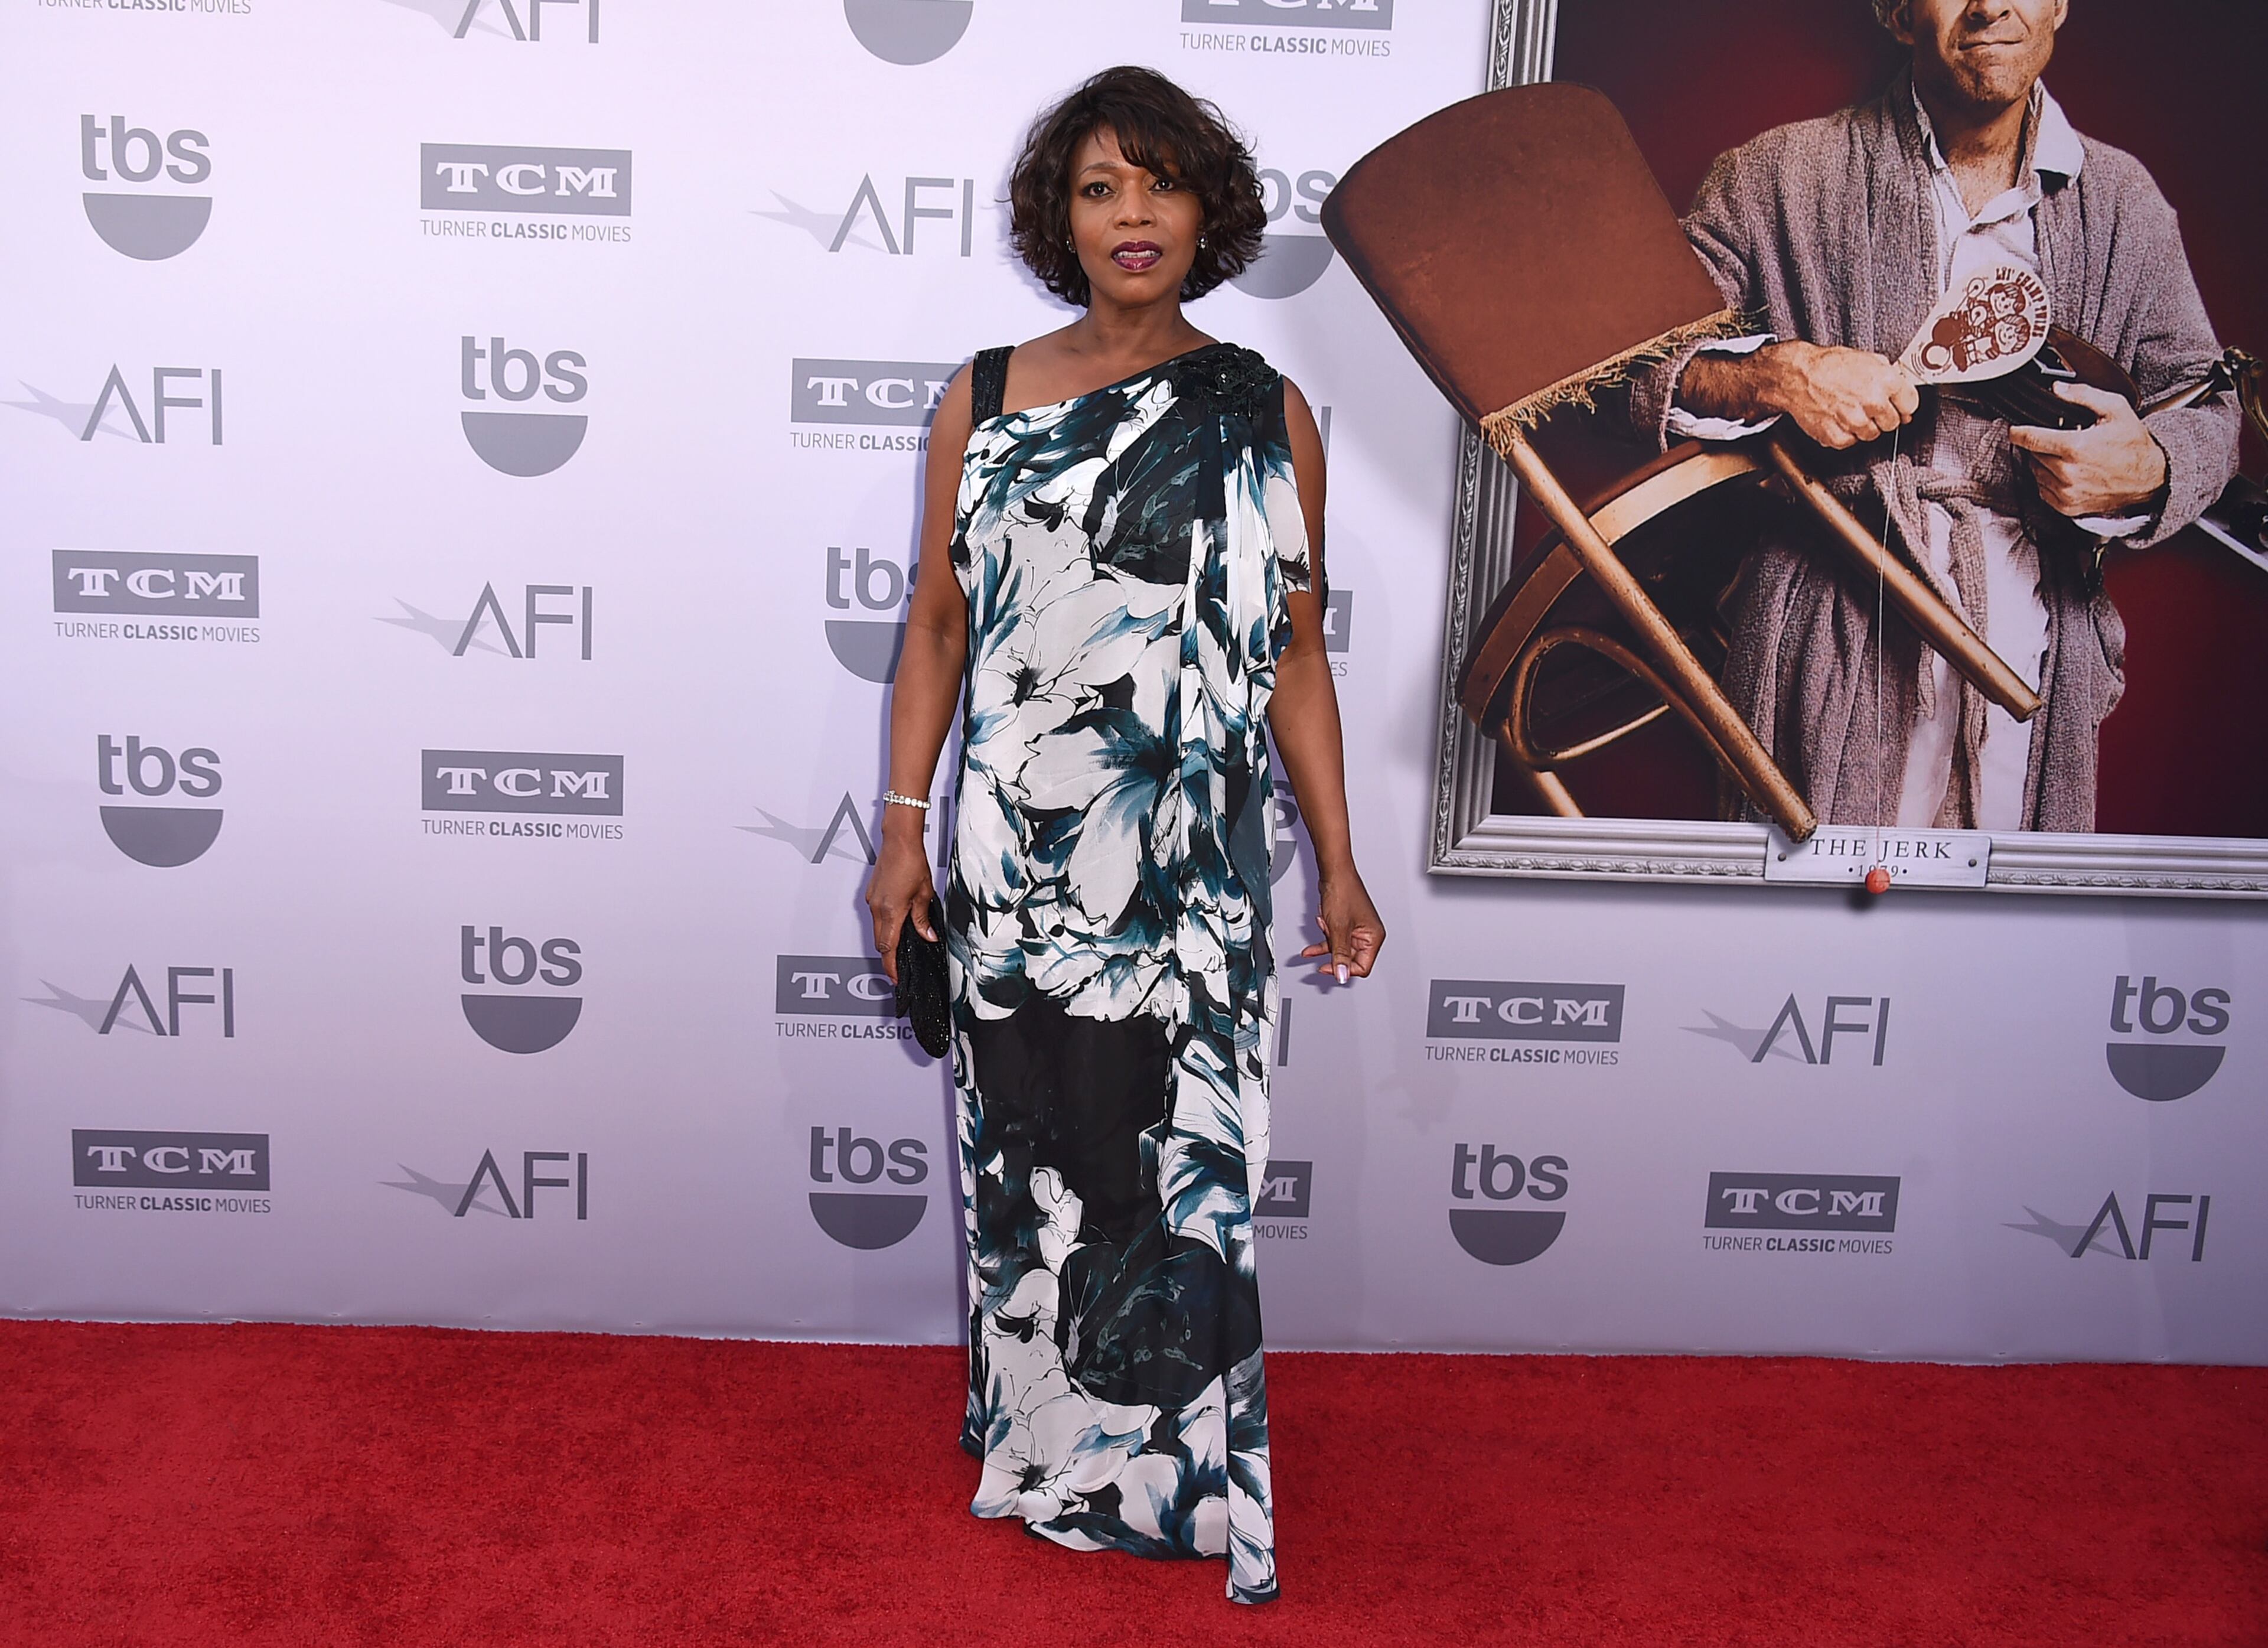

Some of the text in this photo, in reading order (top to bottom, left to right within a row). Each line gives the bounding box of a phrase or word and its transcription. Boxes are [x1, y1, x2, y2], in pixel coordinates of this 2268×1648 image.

[191, 0, 251, 14] MOVIES
[1180, 33, 1390, 57] TURNER CLASSIC MOVIES
[81, 115, 211, 184] tbs
[436, 162, 617, 197] TCM
[1243, 157, 1337, 223] bs
[421, 220, 631, 242] TURNER CLASSIC MOVIES
[828, 173, 973, 257] AFI
[2032, 305, 2047, 337] TWINS
[462, 336, 587, 403] tbs
[81, 364, 223, 445] AFI
[790, 432, 855, 449] TURNER
[68, 568, 245, 600] TCM
[54, 622, 260, 643] TURNER CLASSIC MOVIES
[452, 581, 592, 660] AFI
[98, 735, 221, 797] tbs
[436, 768, 609, 798] TCM
[422, 820, 623, 839] TURNER CLASSIC MOVIES
[811, 791, 949, 868] AI
[1810, 839, 1951, 862] THE JERK
[462, 926, 582, 986] tbs
[99, 963, 234, 1038] AFI
[790, 972, 893, 1001] TC
[1443, 996, 1609, 1025] TCM
[2110, 976, 2230, 1035] tbs
[775, 1022, 913, 1040] TURNER CLASSIC
[1751, 992, 1890, 1066] AFI
[1425, 1046, 1618, 1065] TURNER CLASSIC MOVIES
[87, 1147, 256, 1174] TCM
[810, 1126, 928, 1184] tbs
[454, 1148, 588, 1220] AFI
[1452, 1144, 1568, 1201] tbs
[74, 1195, 271, 1213] TURNER CLASSIC MOVIES
[1722, 1188, 1885, 1216] TCM
[1253, 1224, 1308, 1239] MOVIES
[2070, 1190, 2210, 1262] AFI
[1703, 1236, 1892, 1254] TURNER CLASSIC MOVIES
